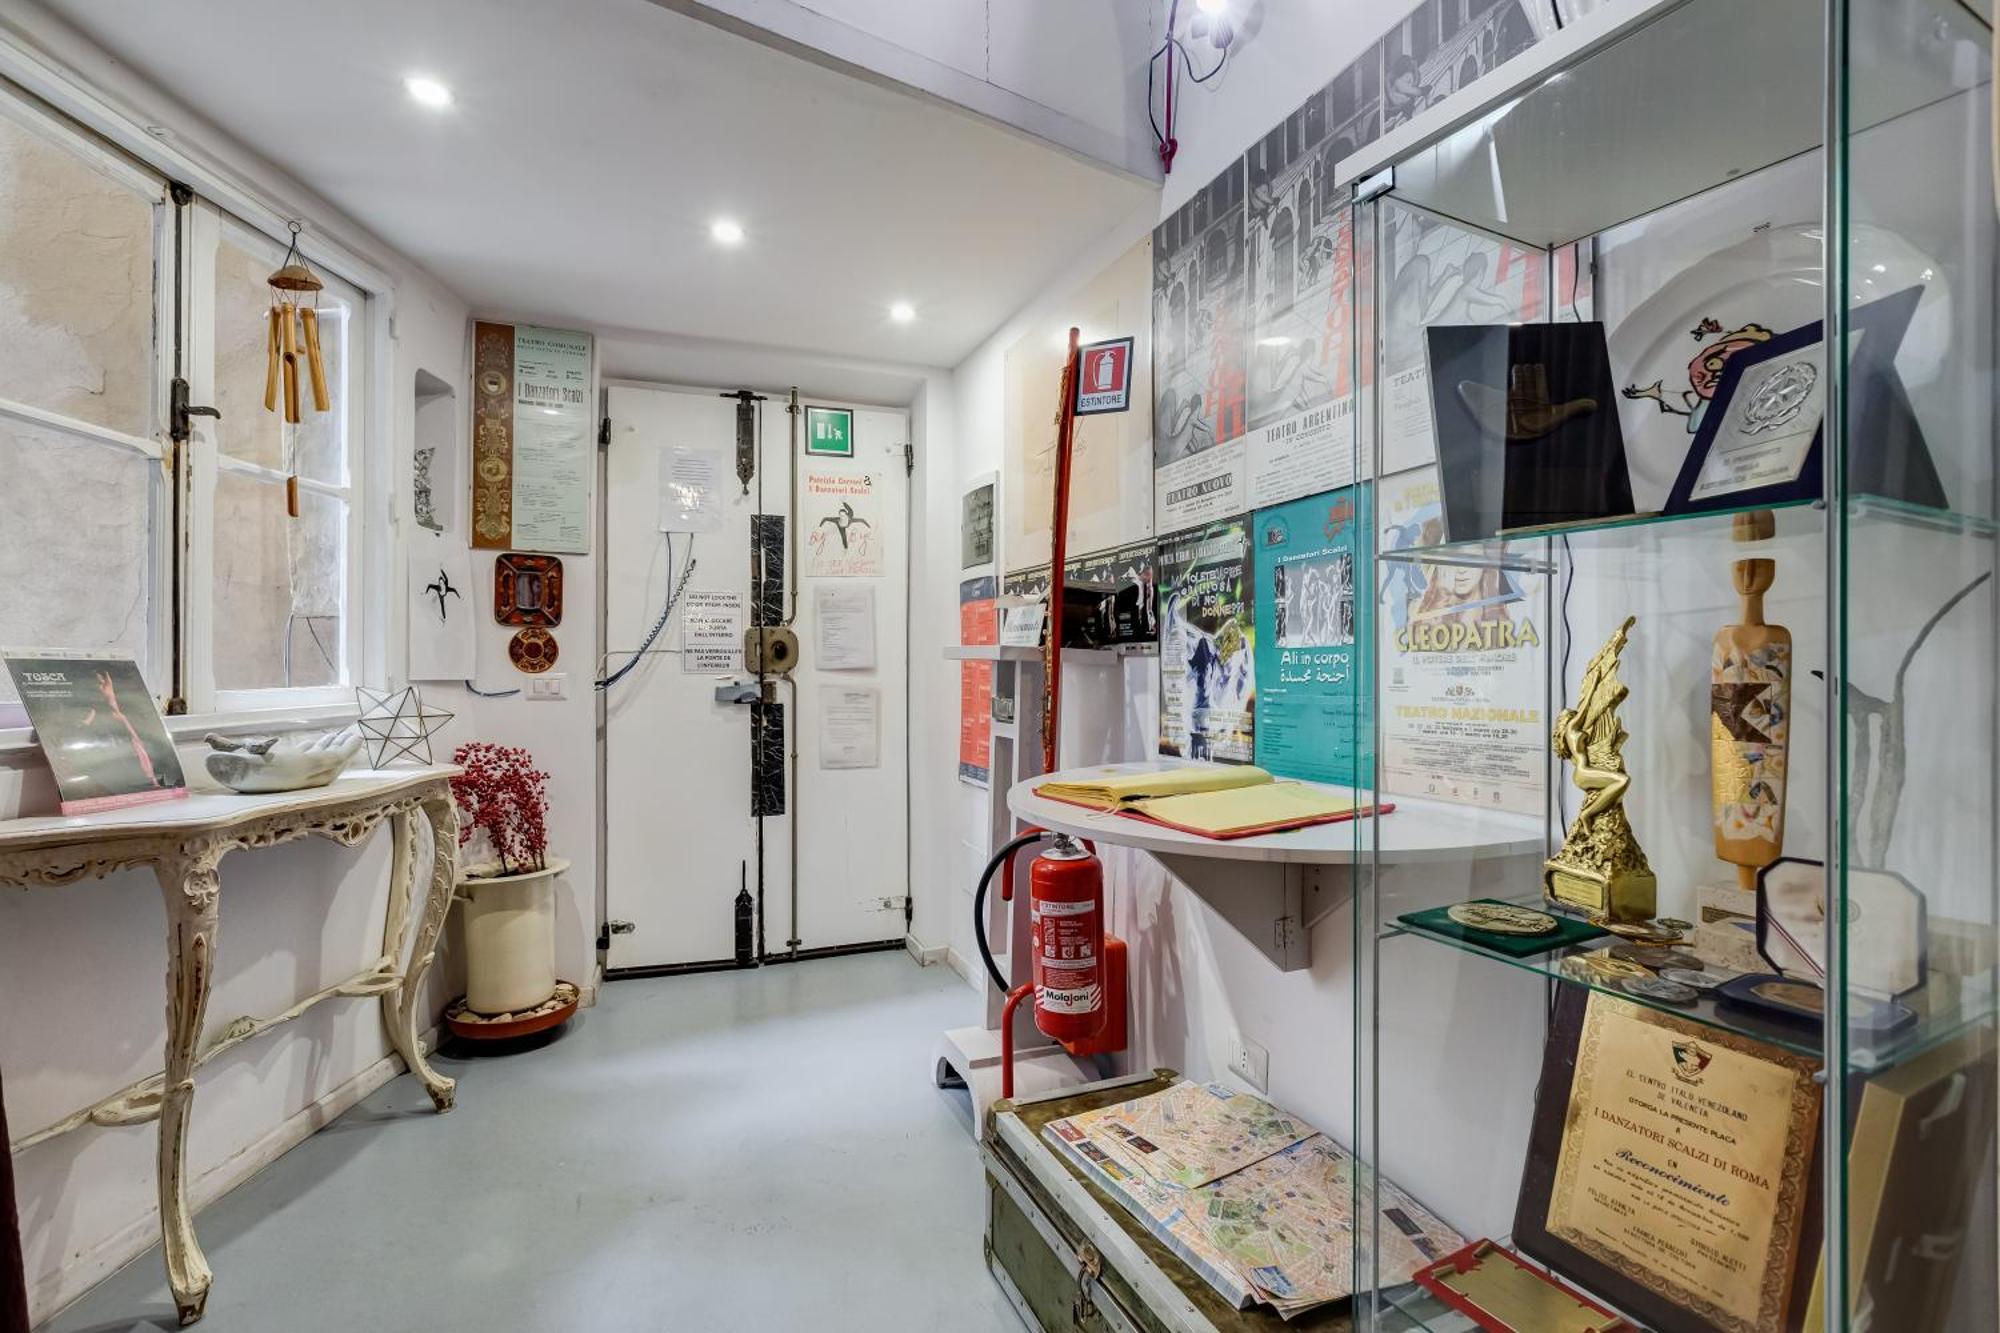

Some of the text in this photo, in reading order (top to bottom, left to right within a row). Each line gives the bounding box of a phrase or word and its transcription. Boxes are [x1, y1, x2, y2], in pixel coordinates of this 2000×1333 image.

[1393, 368, 1426, 387] TEAT
[1080, 394, 1122, 408] ESTINTORE
[1267, 398, 1354, 443] TEATRO ARGENTINA
[1282, 550, 1320, 562] Danzatori
[1322, 544, 1348, 556] Scalzi
[1392, 616, 1540, 653] CLEOPATRA
[1280, 650, 1349, 669] Ali in corpo
[22, 672, 67, 681] TOSCA
[1396, 705, 1540, 723] TEATRO NAZIONALE
[1046, 989, 1089, 1006] Molajoni
[1638, 1074, 1666, 1090] CENTRO
[1671, 1086, 1694, 1101] ITALO
[1698, 1096, 1749, 1122] VENEZOLANO
[1671, 1097, 1709, 1118] VALENCIA
[1628, 1096, 1737, 1145] OTORGA LA PRESENTE PLACA
[1601, 1109, 1665, 1145] DANZATORI
[1667, 1138, 1709, 1164] SCALZI
[1713, 1157, 1727, 1172] DI
[1731, 1165, 1770, 1190] ROMA
[1667, 1159, 1678, 1169] EN
[1615, 1149, 1730, 1206] Reconocimiento
